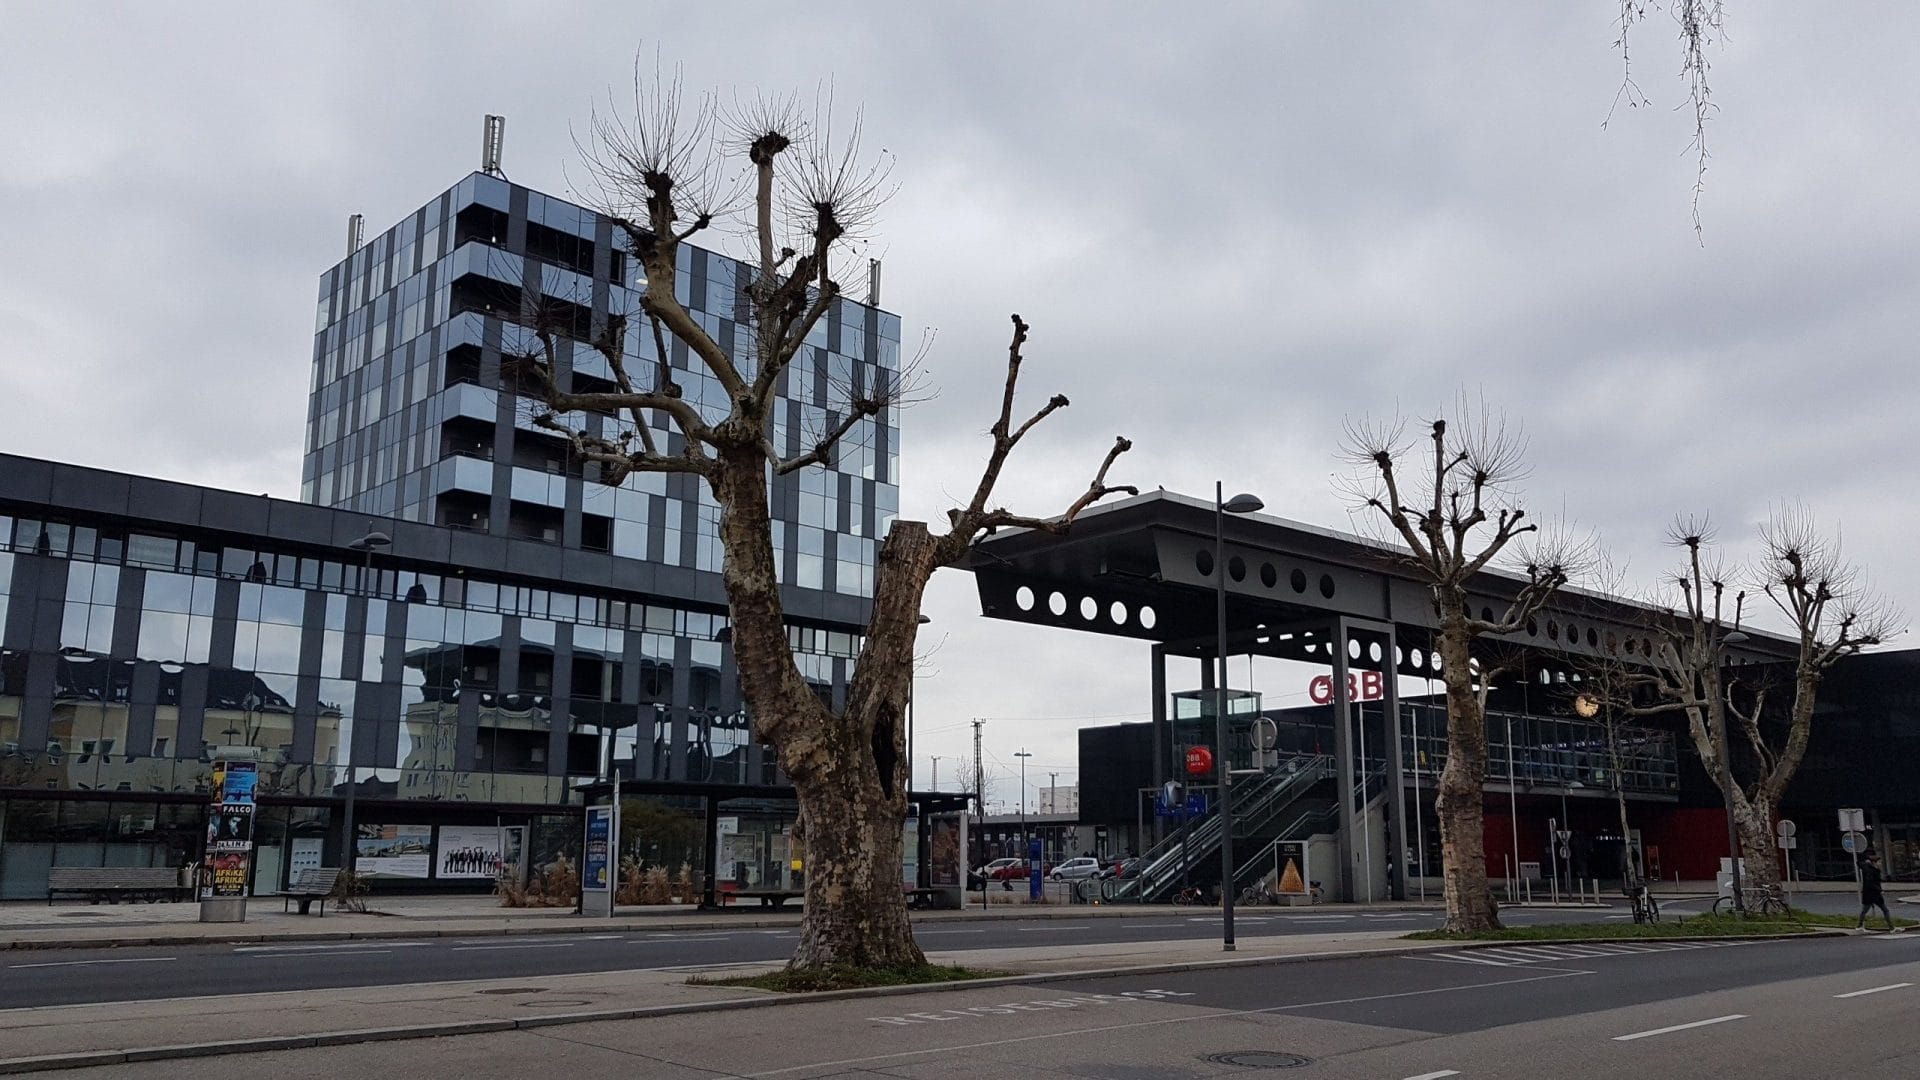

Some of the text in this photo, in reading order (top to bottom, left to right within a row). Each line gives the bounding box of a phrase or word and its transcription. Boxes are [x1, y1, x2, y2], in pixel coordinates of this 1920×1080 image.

[222, 805, 251, 813] FALCO
[215, 869, 245, 877] AFRIKA!
[215, 876, 245, 884] AFRIKA!
[865, 988, 1196, 1025] REISEBUSSE
